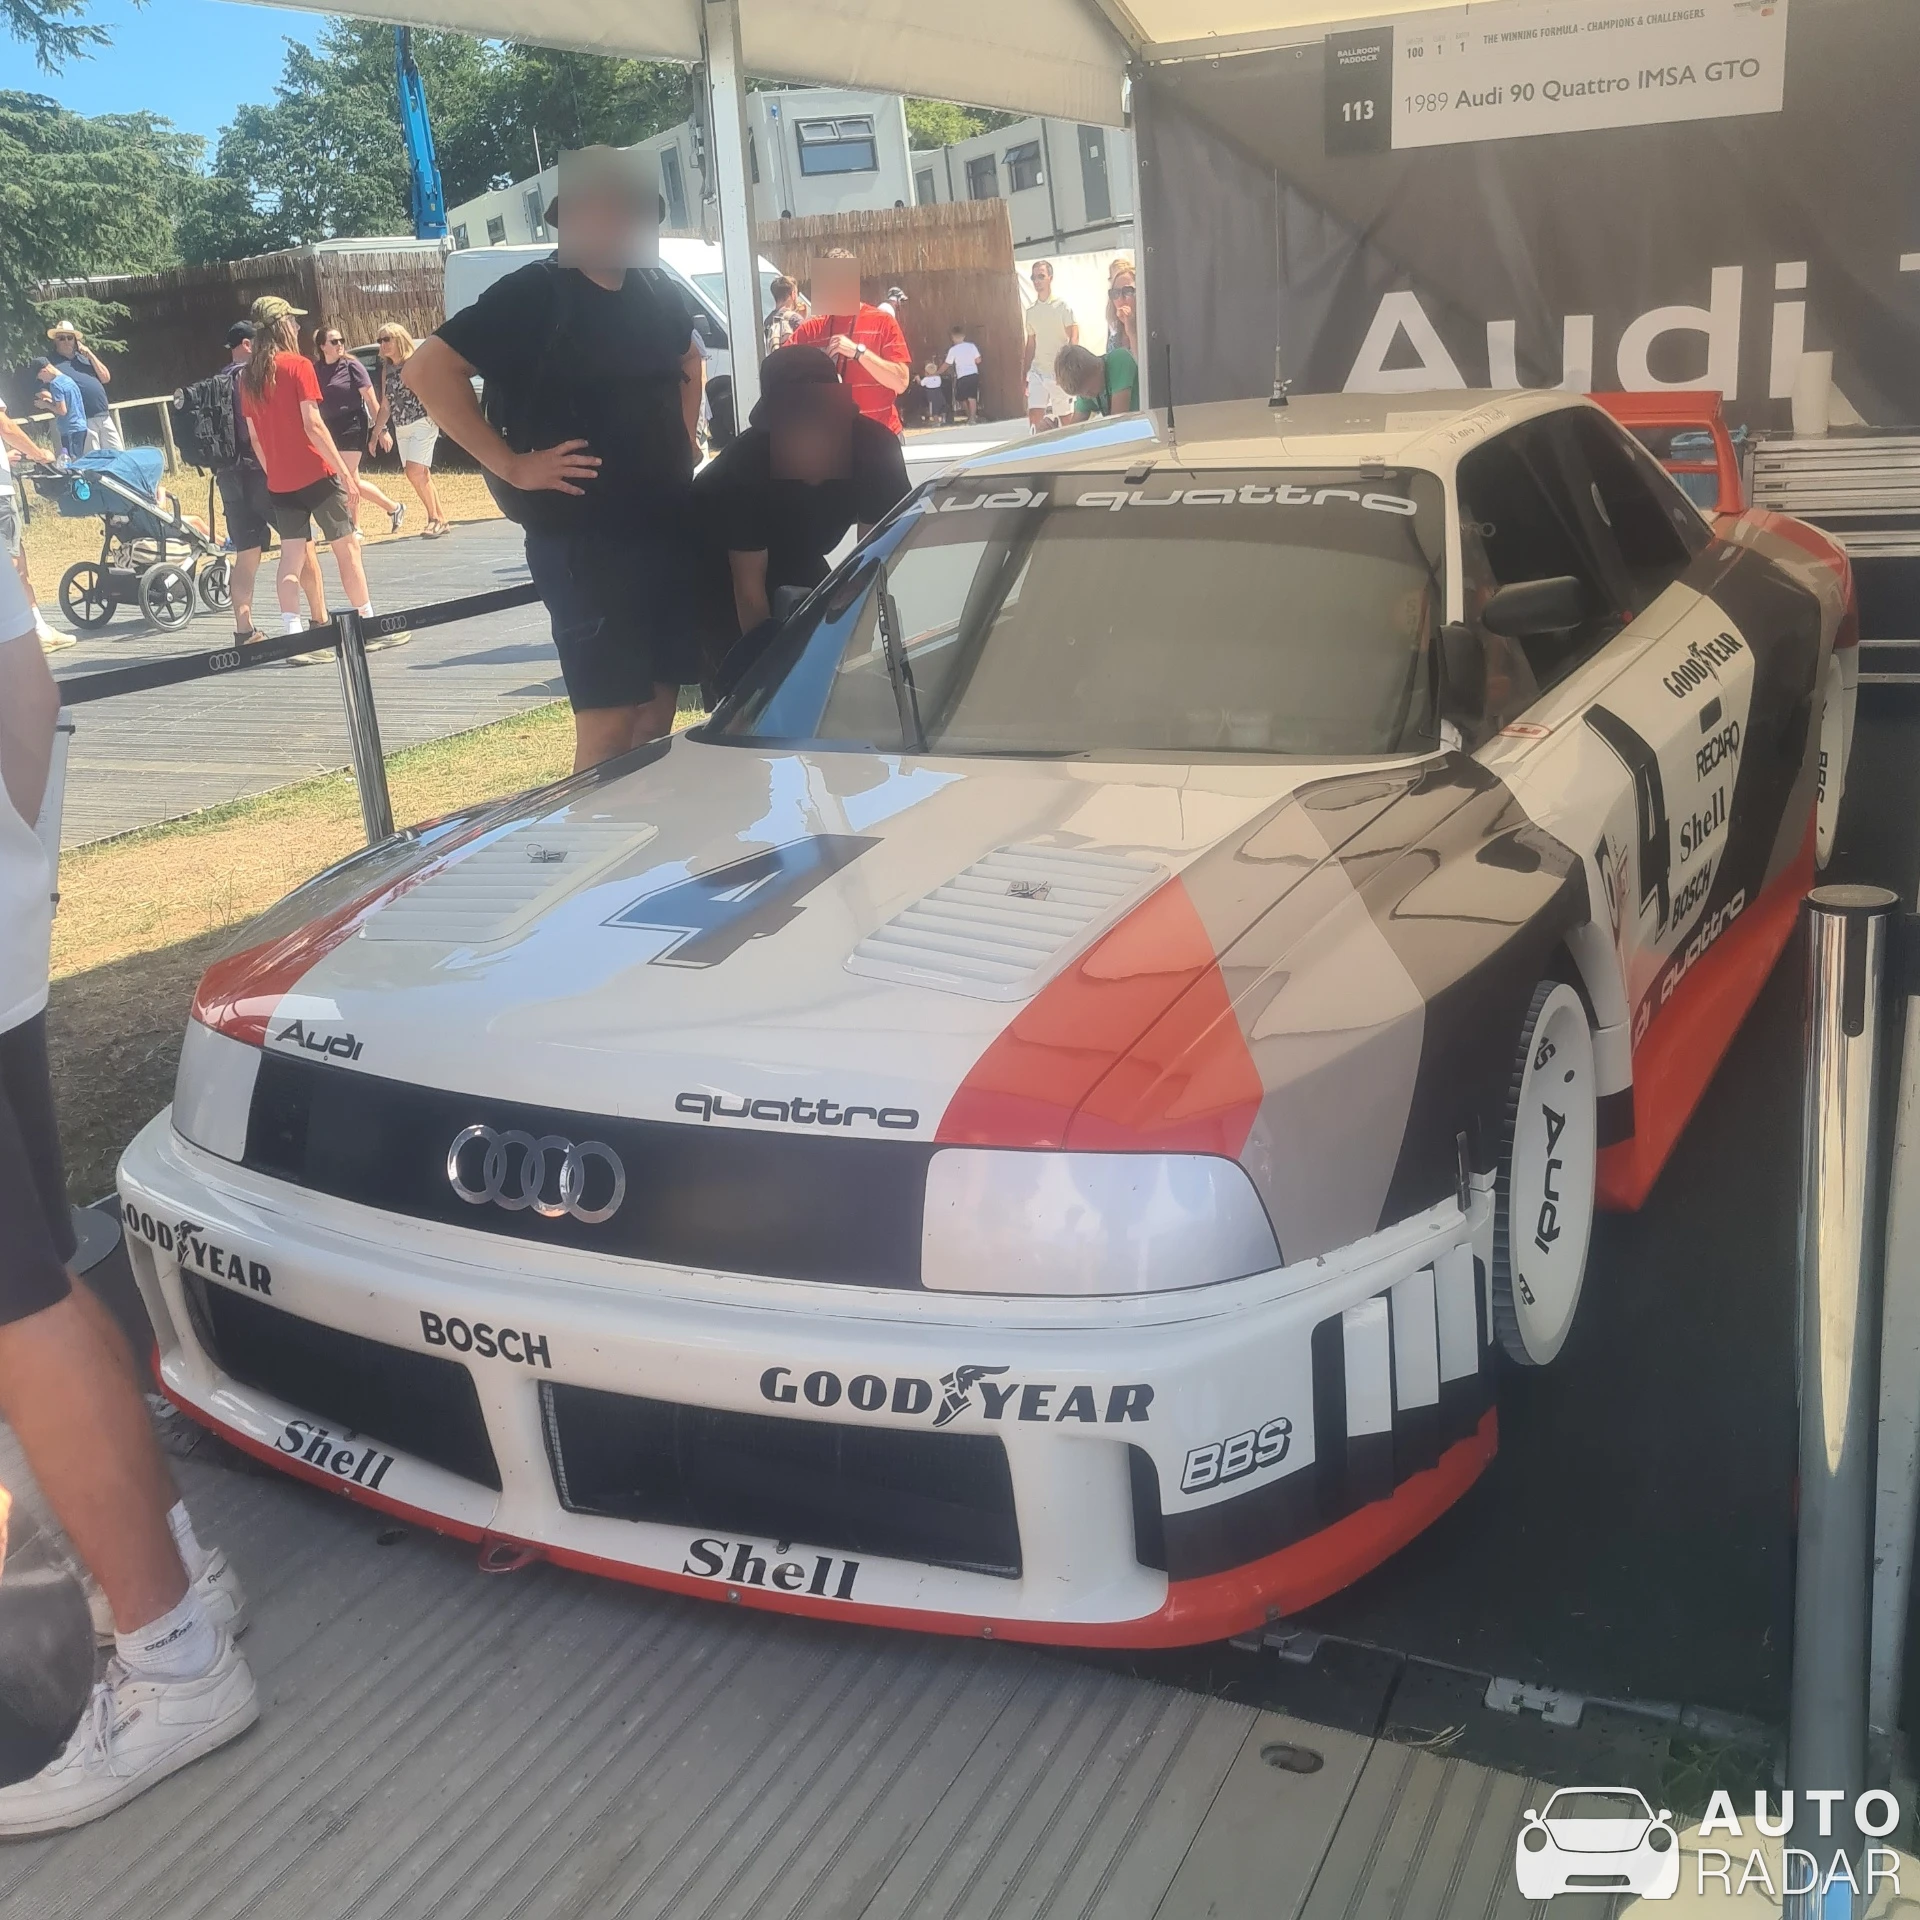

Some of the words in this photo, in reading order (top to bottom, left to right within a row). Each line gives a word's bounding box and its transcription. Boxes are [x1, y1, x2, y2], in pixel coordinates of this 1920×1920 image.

[1337, 45, 1381, 58] BALLROOM
[1406, 46, 1424, 60] 100
[1437, 44, 1442, 55] 1
[1459, 41, 1465, 53] 1
[1483, 34, 1498, 45] THE
[1500, 29, 1538, 43] WINNING
[1540, 23, 1578, 38] FORMULA
[1586, 16, 1636, 33] CHAMPIONS
[1636, 16, 1643, 26] &
[1646, 8, 1706, 26] CHALLENGERS
[1339, 53, 1378, 65] PADDOCK
[1404, 92, 1449, 114] 1989
[1455, 87, 1503, 109] Audi
[1510, 83, 1535, 103] 90
[1542, 77, 1630, 102] Quattro
[1638, 65, 1697, 90] IMSA
[1704, 57, 1760, 82] GTO
[1342, 100, 1375, 122] 113
[1341, 261, 1807, 401] Audi
[885, 487, 1049, 527] Audi
[1076, 483, 1418, 517] quattro
[1696, 720, 1740, 782] RECARO
[1679, 785, 1726, 863] Shell
[1671, 858, 1713, 932] BOSCH
[1660, 887, 1746, 1005] quattro
[275, 1019, 364, 1061] Audi
[675, 1092, 920, 1130] quattro
[1534, 1103, 1566, 1256] Audi
[419, 1310, 553, 1369] BOSCH
[276, 1420, 396, 1491] Shell
[1180, 1416, 1293, 1495] BBS
[682, 1538, 861, 1601] Shell
